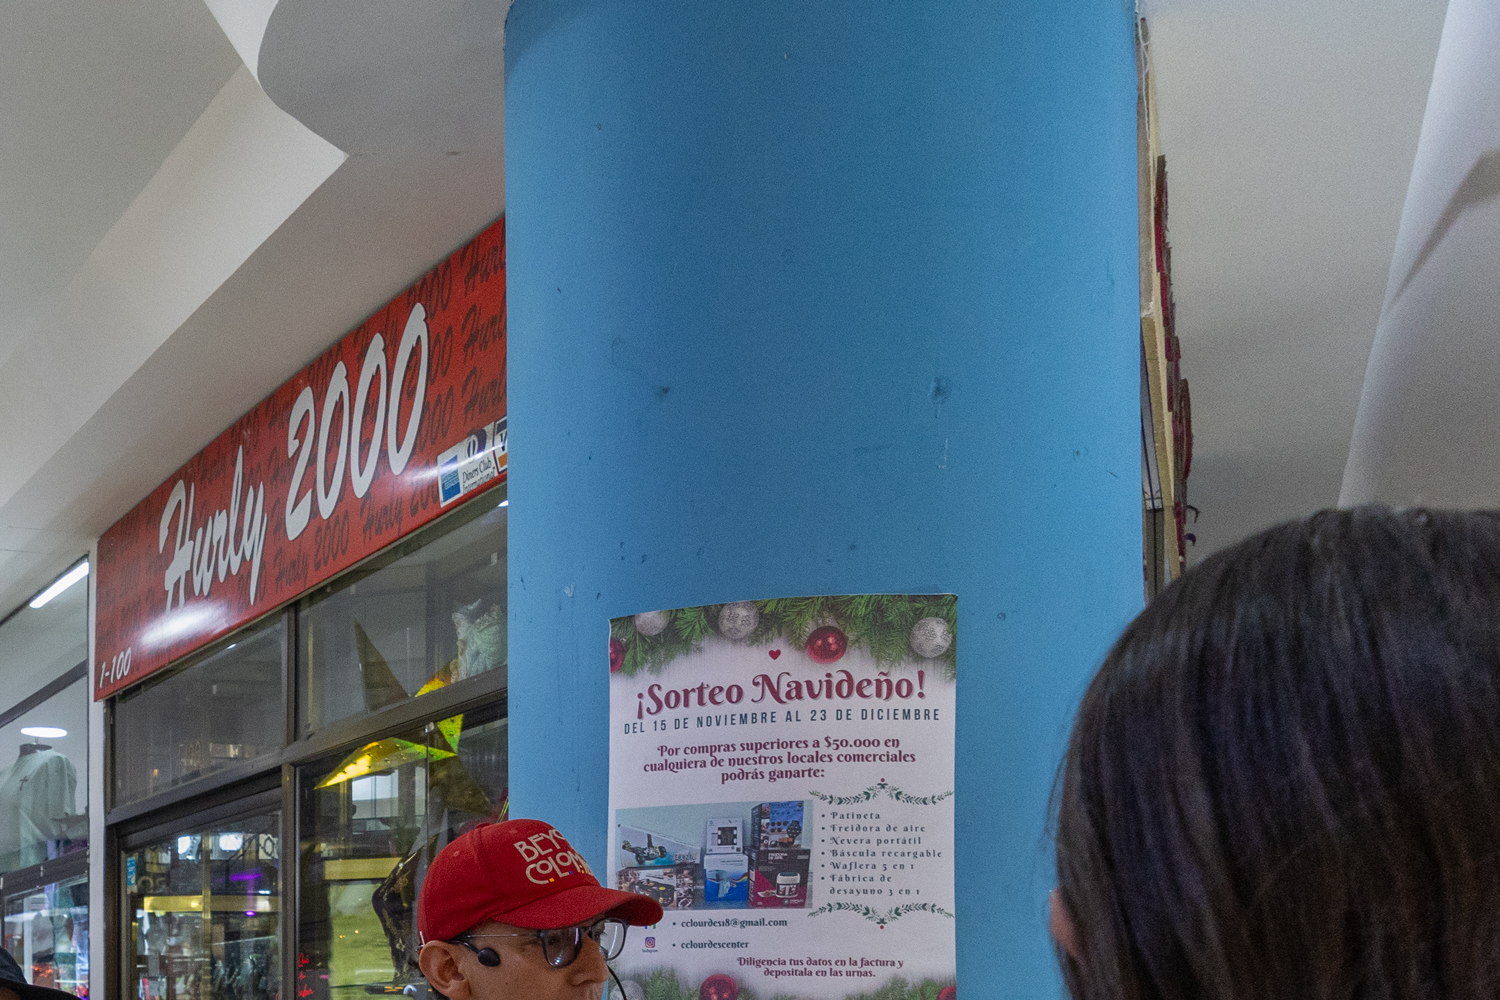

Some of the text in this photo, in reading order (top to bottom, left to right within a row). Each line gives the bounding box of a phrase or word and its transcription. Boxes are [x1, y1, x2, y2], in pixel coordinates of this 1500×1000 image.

[159, 303, 429, 613] Hurly 2000
[314, 509, 349, 562] 2000
[100, 647, 131, 689] 1-100
[637, 670, 926, 720] ¡Sorteo Navideño!
[624, 708, 940, 734] DEL 15 DE NOVIEMBRE AL 23 DE DICIEMBRE
[657, 736, 900, 757] Por compras superiores a $50.000 en
[643, 750, 916, 773] cualquiera de nuestros locales comerciales
[721, 767, 825, 784] podrás ganarte:
[830, 811, 880, 820] Patineta
[830, 824, 880, 832] Freidora
[885, 824, 898, 832] de
[830, 837, 921, 847] Nevera portátil
[830, 849, 942, 859] Báscula recargable
[525, 850, 595, 885] COLOM
[830, 862, 877, 871] Waflera
[830, 874, 892, 882] Fábrica de
[829, 886, 883, 896] desayuno
[681, 918, 788, 929] cclourdes18@gmail.com
[681, 940, 749, 949] cclourdescenter
[737, 957, 904, 969] Diligencia tus datos en la factura y
[815, 969, 827, 978] en
[829, 967, 843, 977] las
[845, 969, 876, 978] urnas.
